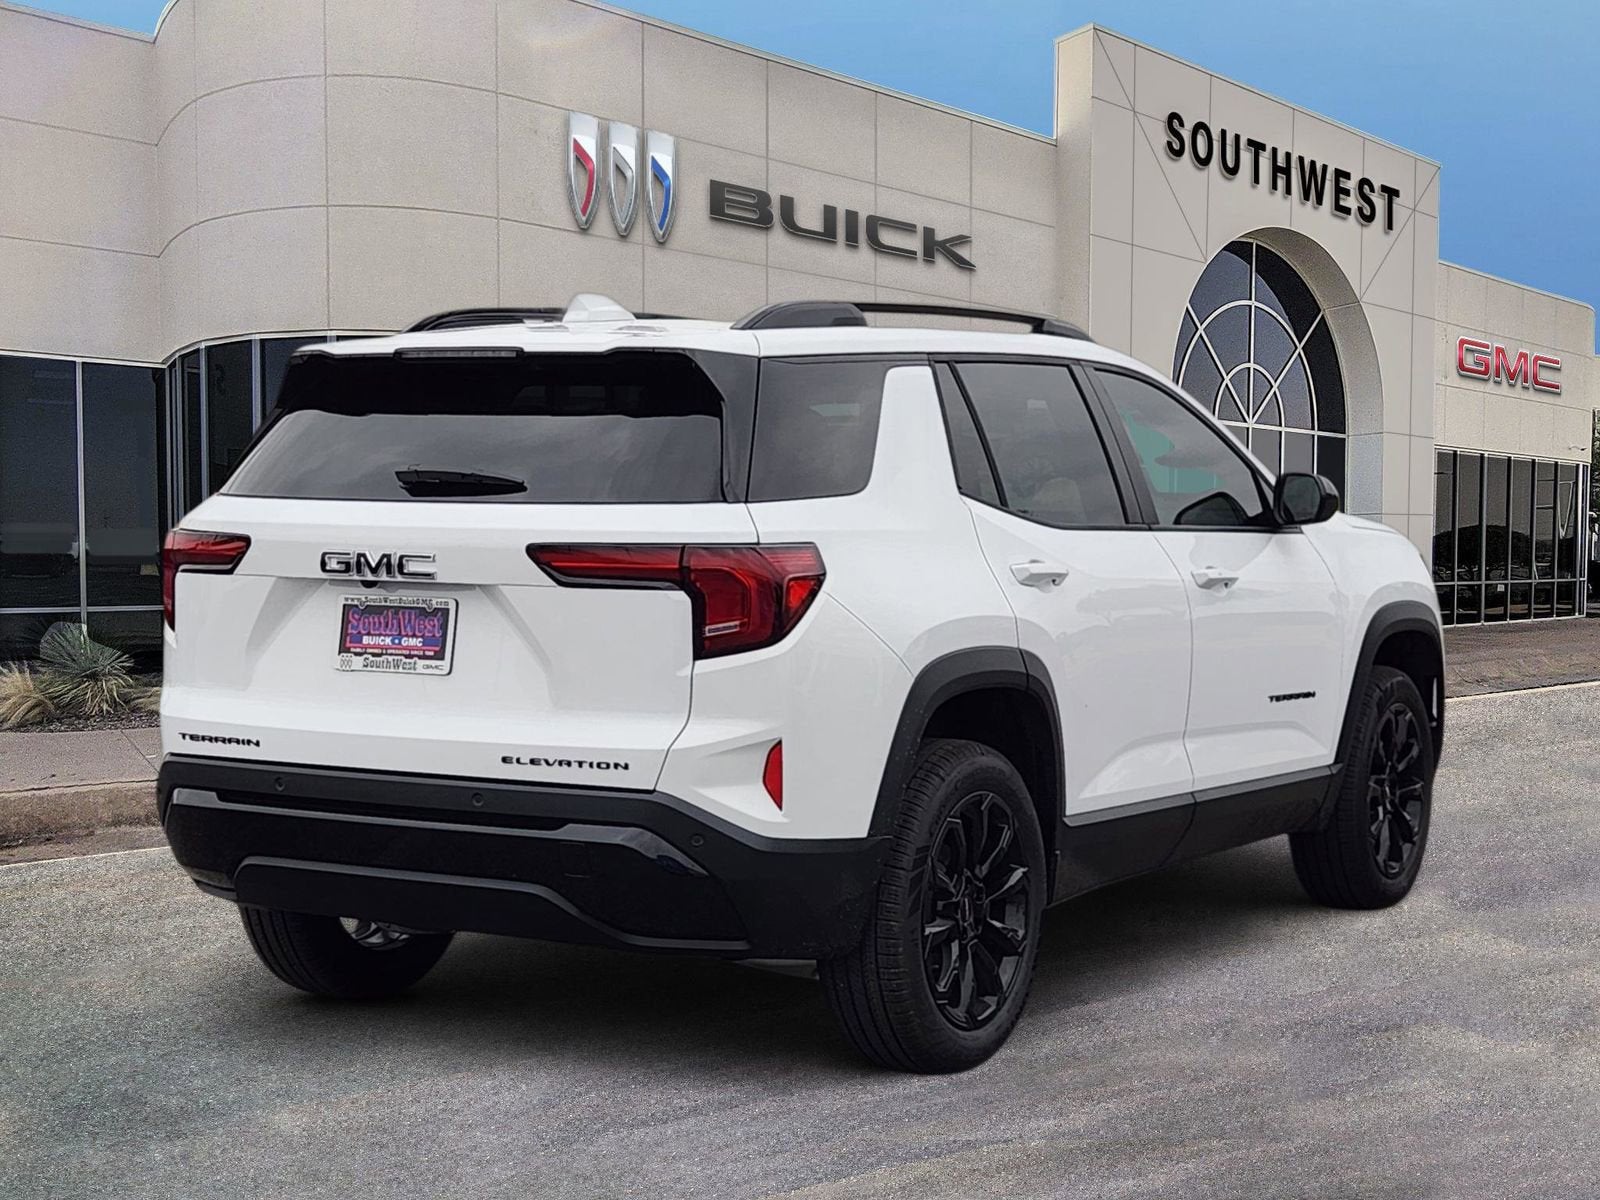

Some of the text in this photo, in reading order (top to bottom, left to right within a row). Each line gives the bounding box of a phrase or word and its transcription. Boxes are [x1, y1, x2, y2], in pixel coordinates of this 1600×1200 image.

[1166, 111, 1400, 231] SOUTHWEST
[710, 179, 976, 269] BUICK
[1457, 336, 1561, 393] GMC
[320, 551, 437, 579] GMC
[362, 635, 424, 647] BUICK GMC
[1267, 690, 1316, 703] TERRAIN
[178, 732, 260, 748] TERRAIN
[501, 755, 630, 771] ELEVATION
